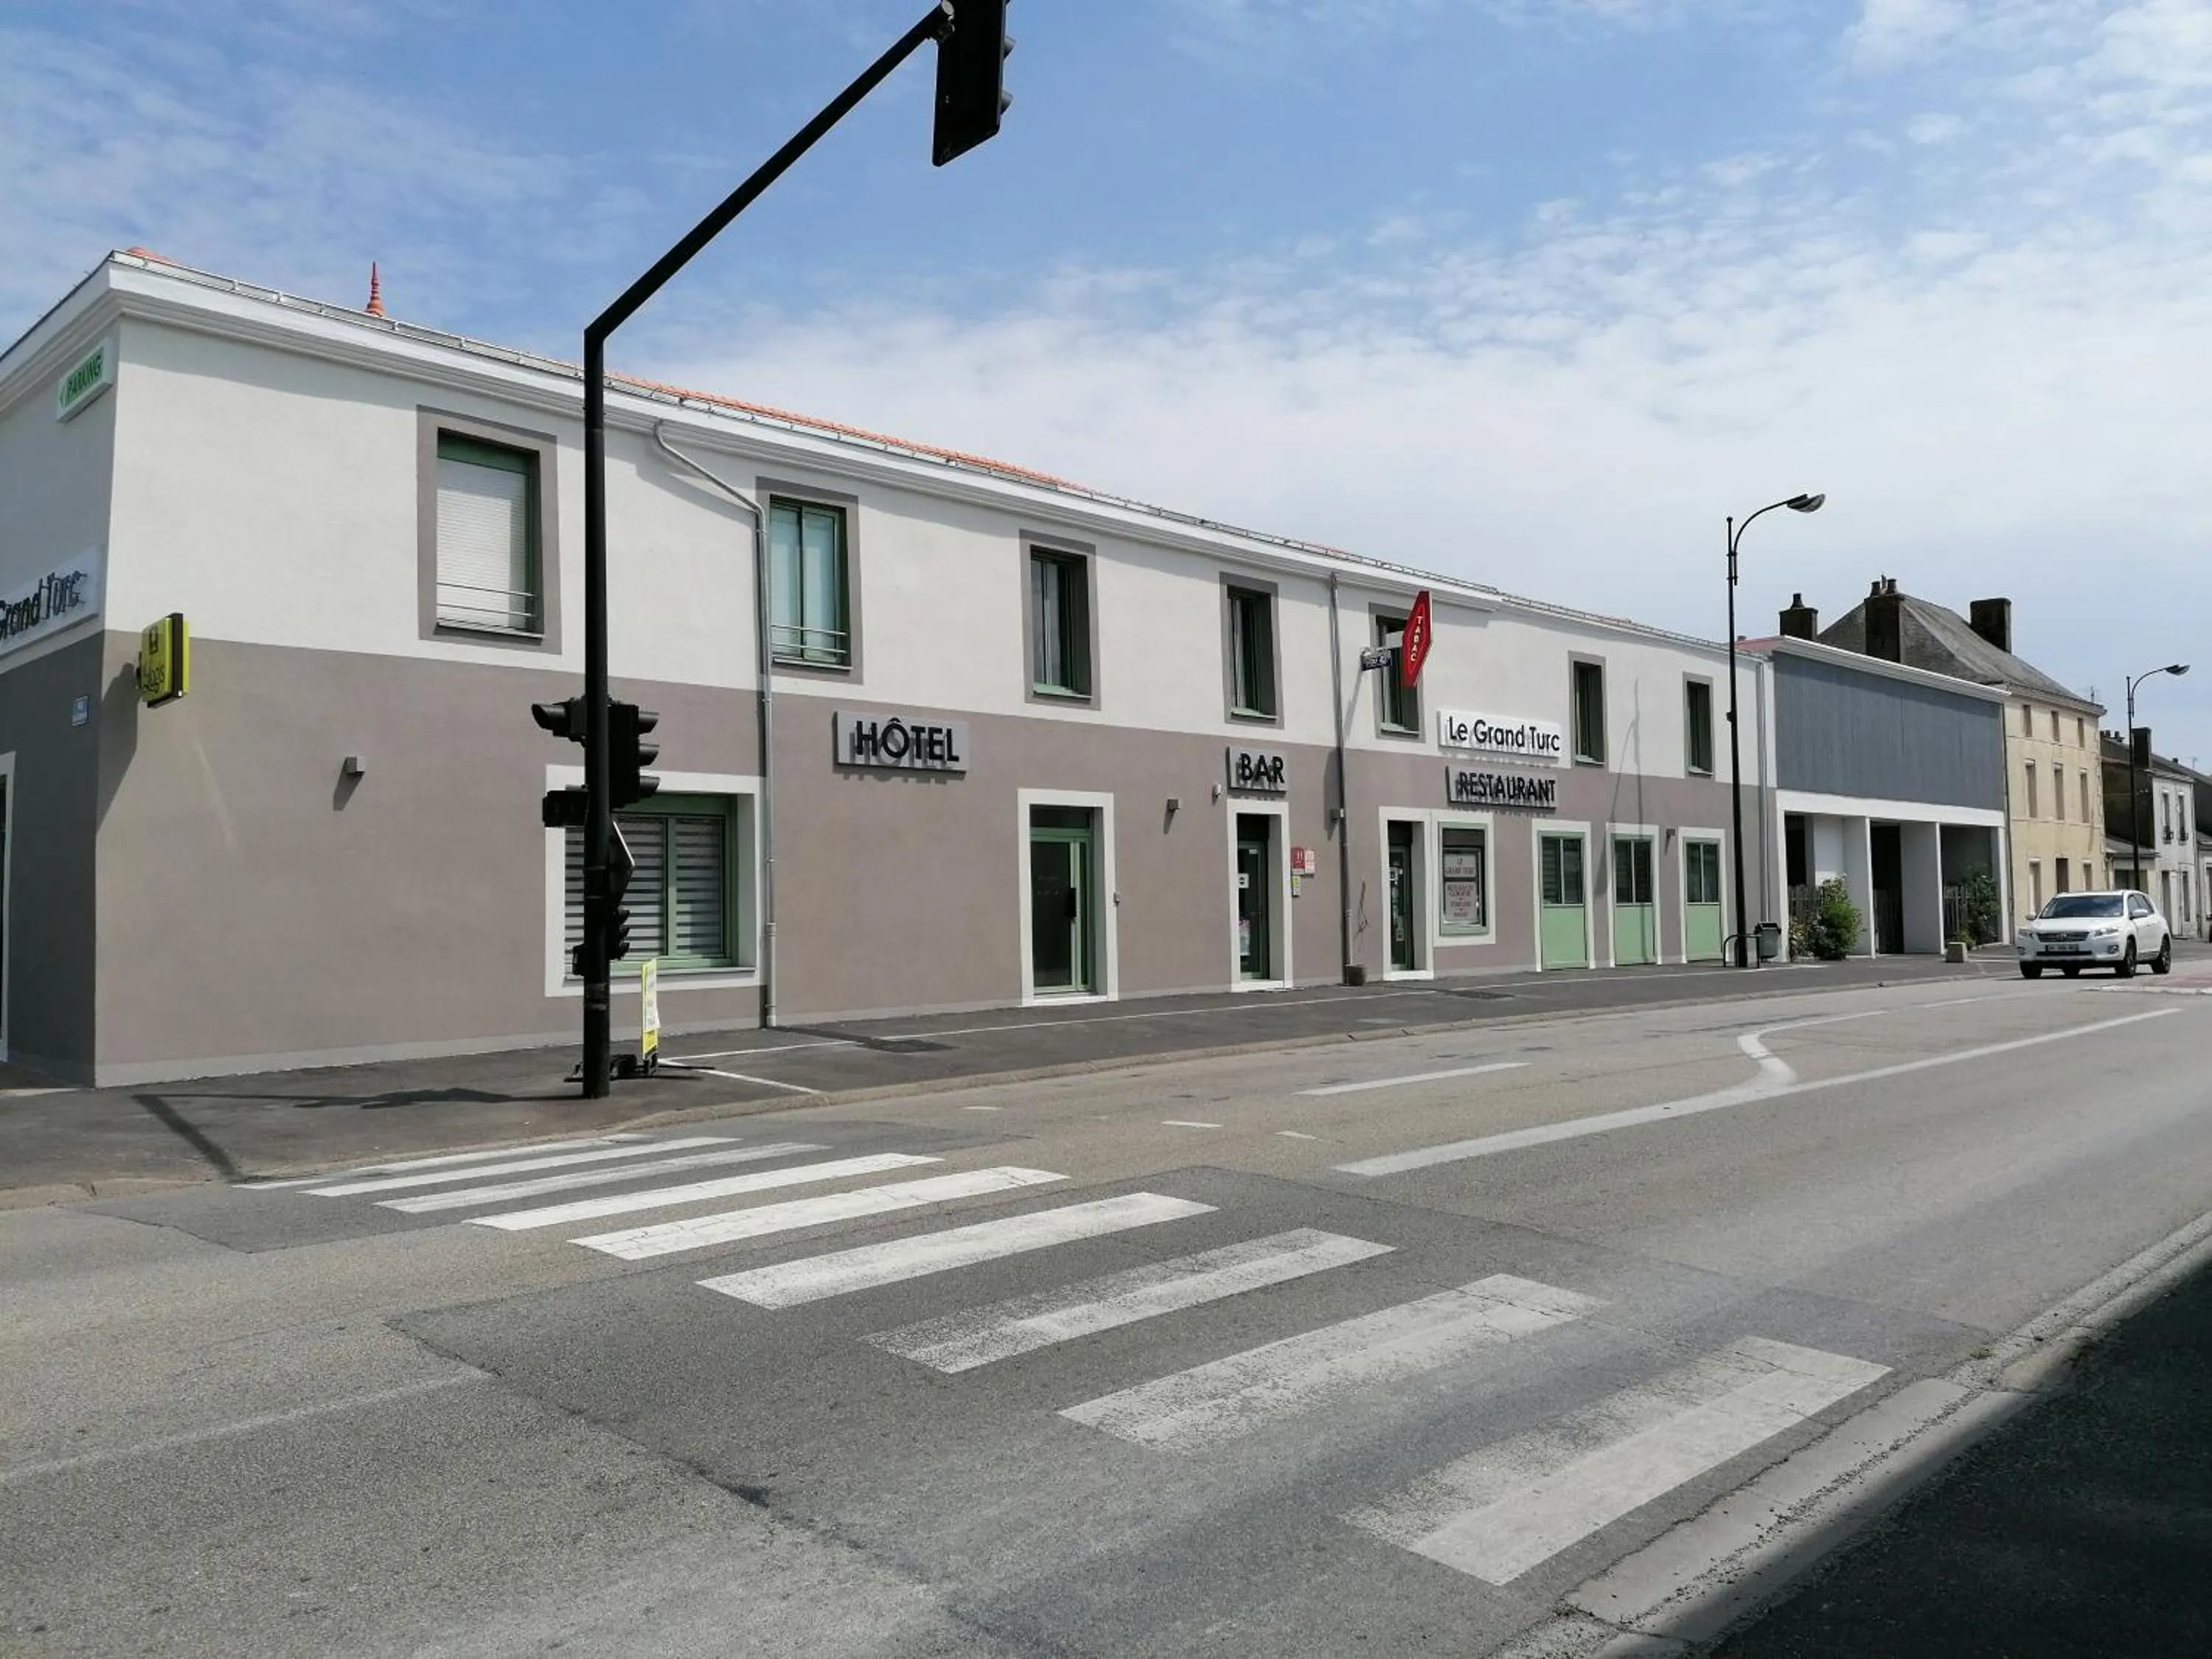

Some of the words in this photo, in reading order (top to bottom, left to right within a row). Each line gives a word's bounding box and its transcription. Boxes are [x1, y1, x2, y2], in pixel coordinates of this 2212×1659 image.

[1411, 615, 1423, 661] TABAC
[855, 717, 960, 762] HÔTEL
[1449, 716, 1468, 741] Le
[1473, 719, 1525, 748] Grand
[1528, 726, 1560, 751] Turc
[1239, 753, 1285, 784] BAR
[1458, 771, 1556, 803] RESTAURANT
